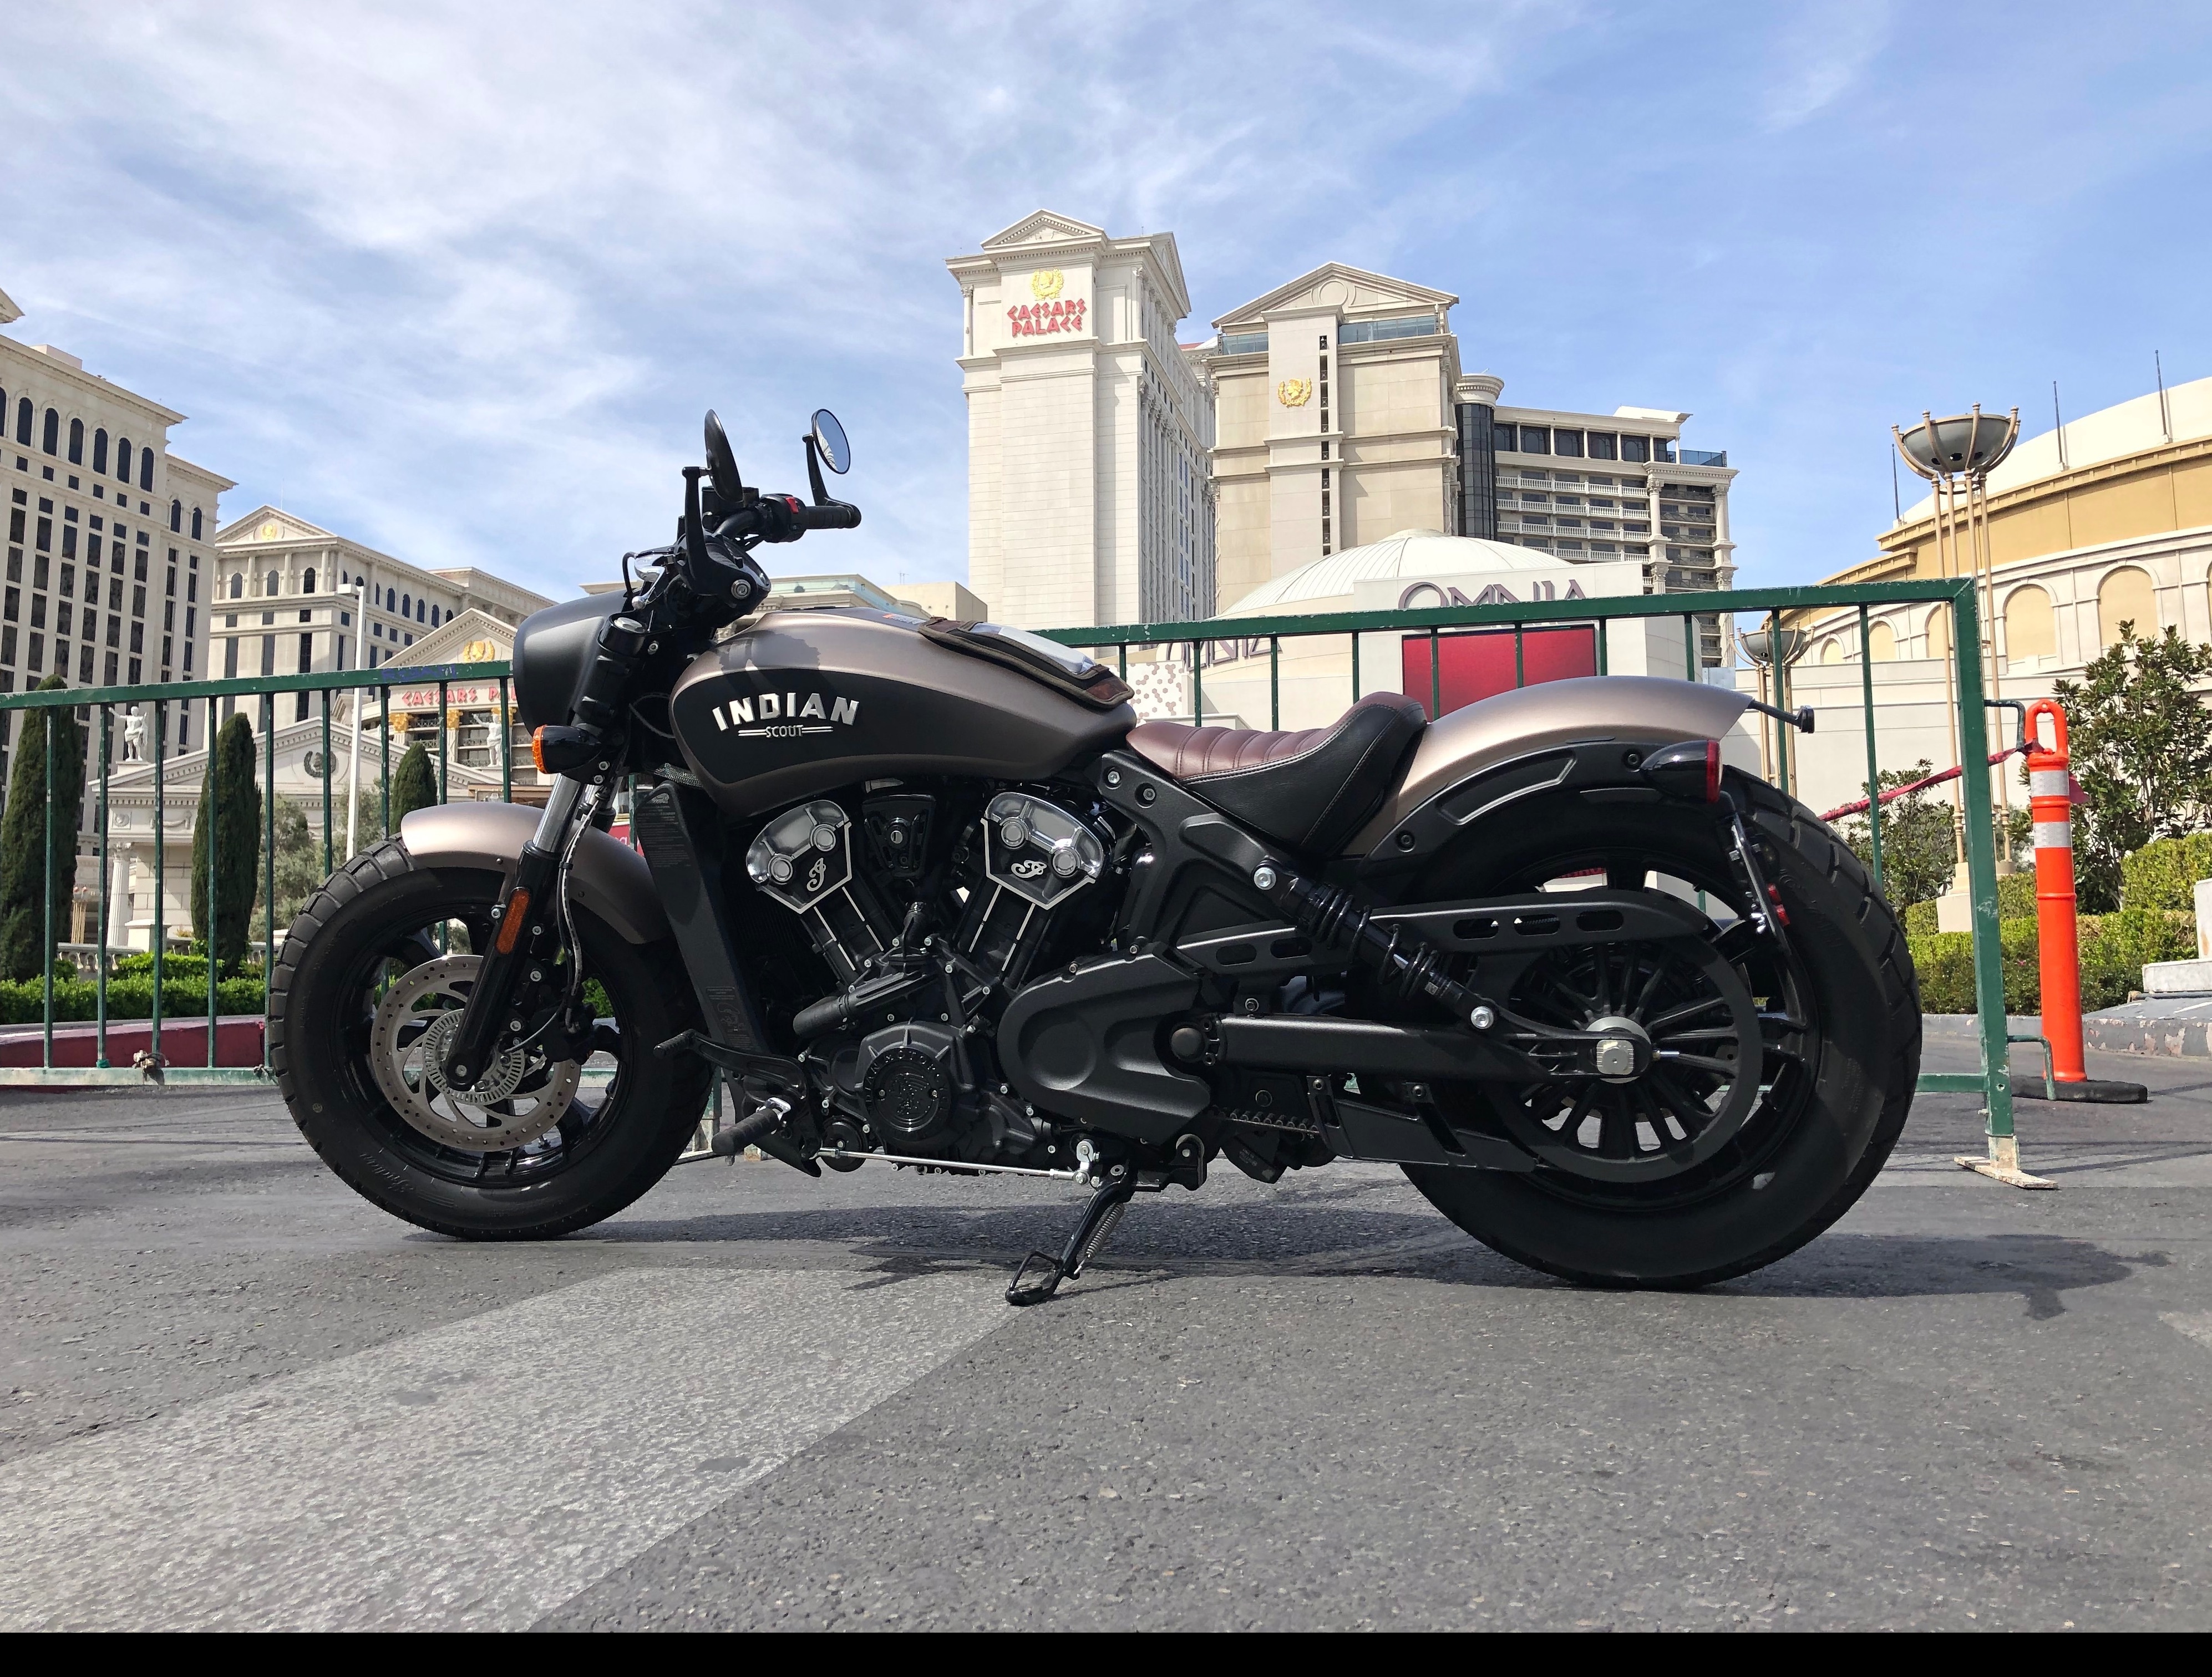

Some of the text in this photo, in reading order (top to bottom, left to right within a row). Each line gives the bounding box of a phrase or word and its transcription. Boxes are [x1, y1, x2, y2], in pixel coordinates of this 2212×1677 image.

[1007, 298, 1087, 321] CAESARS
[1012, 314, 1083, 338] PALACE
[402, 687, 478, 707] CAESARS
[712, 692, 860, 731] INDIAN
[765, 724, 804, 738] SCOUT
